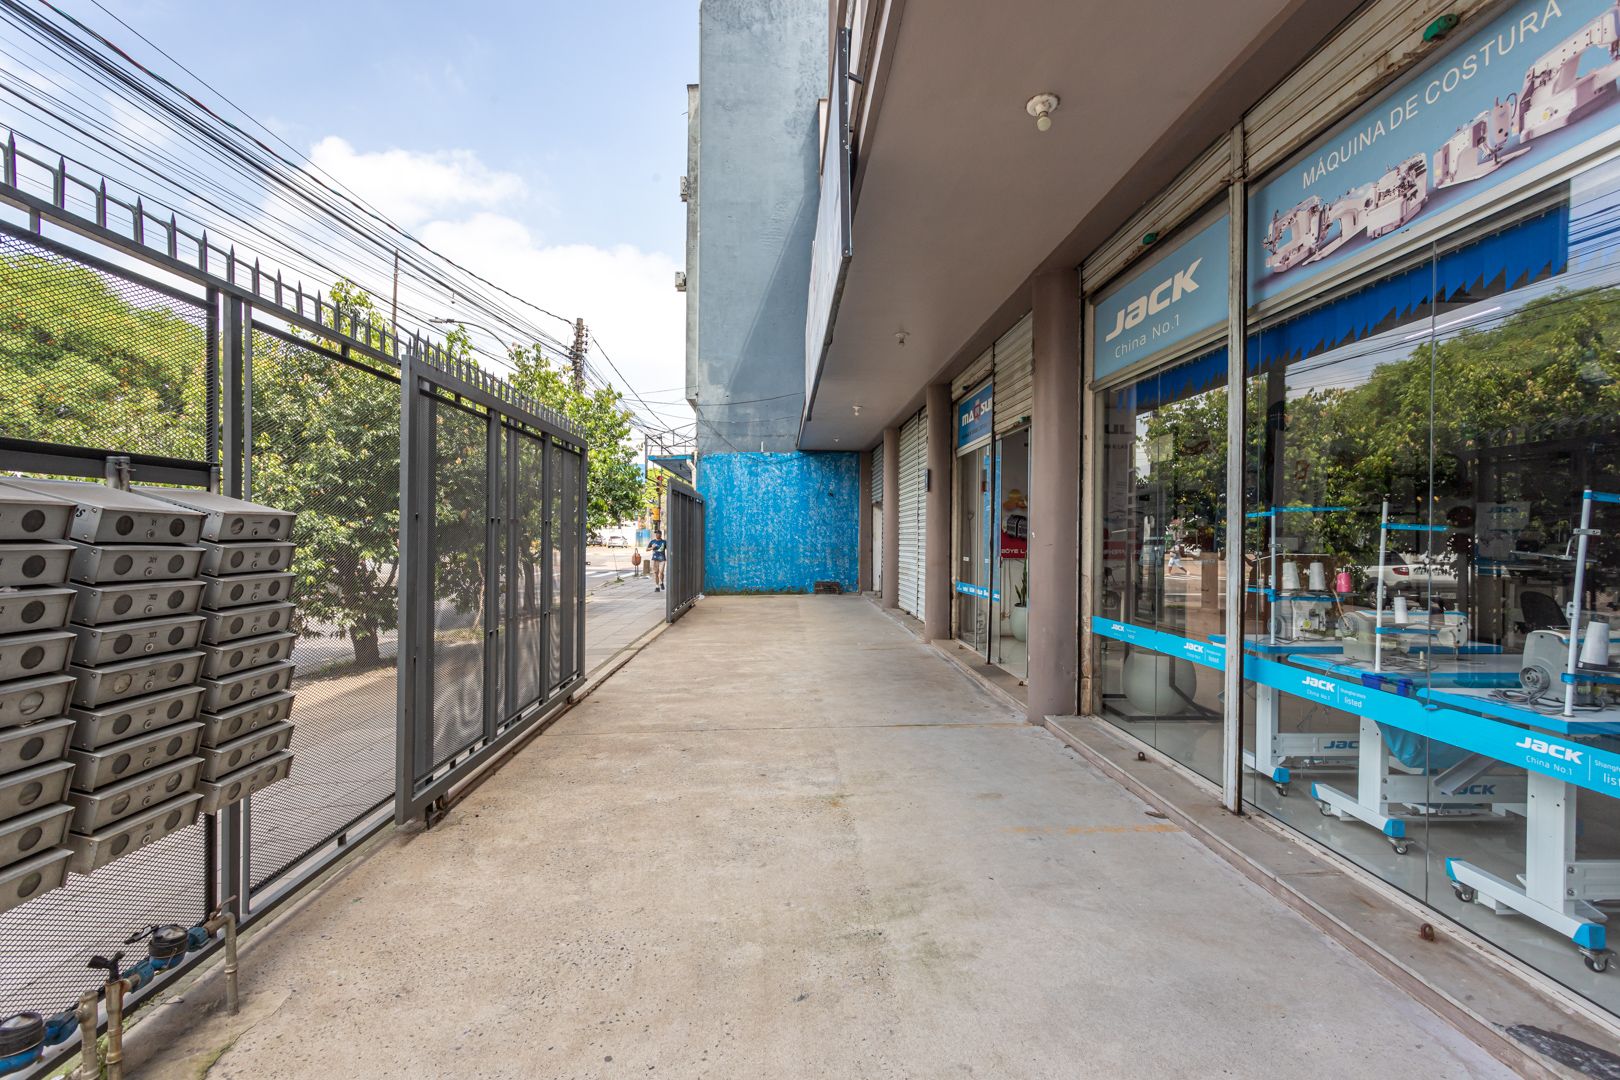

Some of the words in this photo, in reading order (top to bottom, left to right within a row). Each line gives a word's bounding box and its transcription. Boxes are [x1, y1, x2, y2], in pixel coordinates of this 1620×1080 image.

[1303, 120, 1386, 189] MÁQUINA
[1390, 93, 1419, 131] DE
[1425, 0, 1562, 105] COSTURA
[1114, 335, 1147, 358] China
[1152, 313, 1180, 341] No.1
[1344, 697, 1363, 708] listed
[1526, 755, 1550, 769] China
[1553, 764, 1573, 775] No.1
